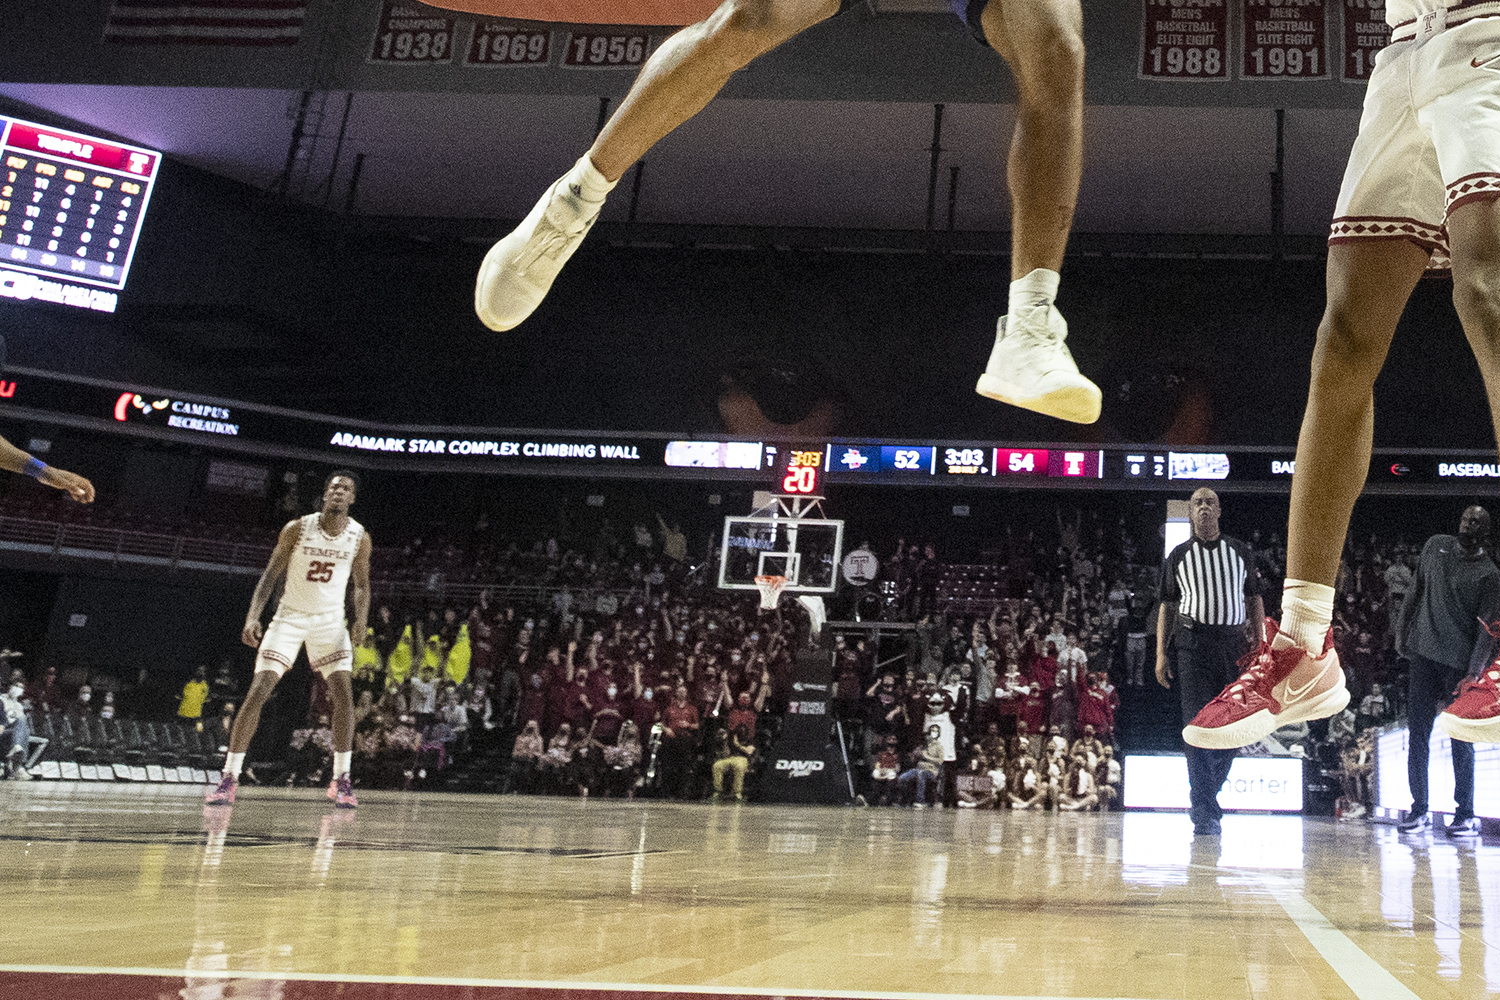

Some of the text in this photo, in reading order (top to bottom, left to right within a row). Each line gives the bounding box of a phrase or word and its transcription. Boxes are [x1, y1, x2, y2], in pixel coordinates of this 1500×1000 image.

[1156, 21, 1217, 32] BASKETBALL
[1255, 21, 1315, 32] BASKETBALL
[379, 32, 449, 59] 1938
[476, 34, 546, 62] 1969
[1157, 34, 1214, 46] ELITE EIGHT
[1257, 34, 1313, 45] ELITE EIGHT
[1357, 36, 1384, 47] ELITE
[573, 36, 642, 64] 1956
[1150, 47, 1220, 75] 1988
[1251, 48, 1318, 74] 1991
[171, 400, 230, 420] CAMPUS
[168, 415, 239, 435] RECREATION
[330, 432, 640, 459] ARAMARK STAR COMPLEX CLIMBING WALL
[894, 450, 920, 469] 52
[944, 449, 984, 466] 3:03
[1008, 453, 1035, 472] 54
[783, 466, 816, 493] 20
[303, 546, 350, 560] TEMPLE
[306, 561, 335, 583] 25
[775, 760, 824, 771] DAVID
